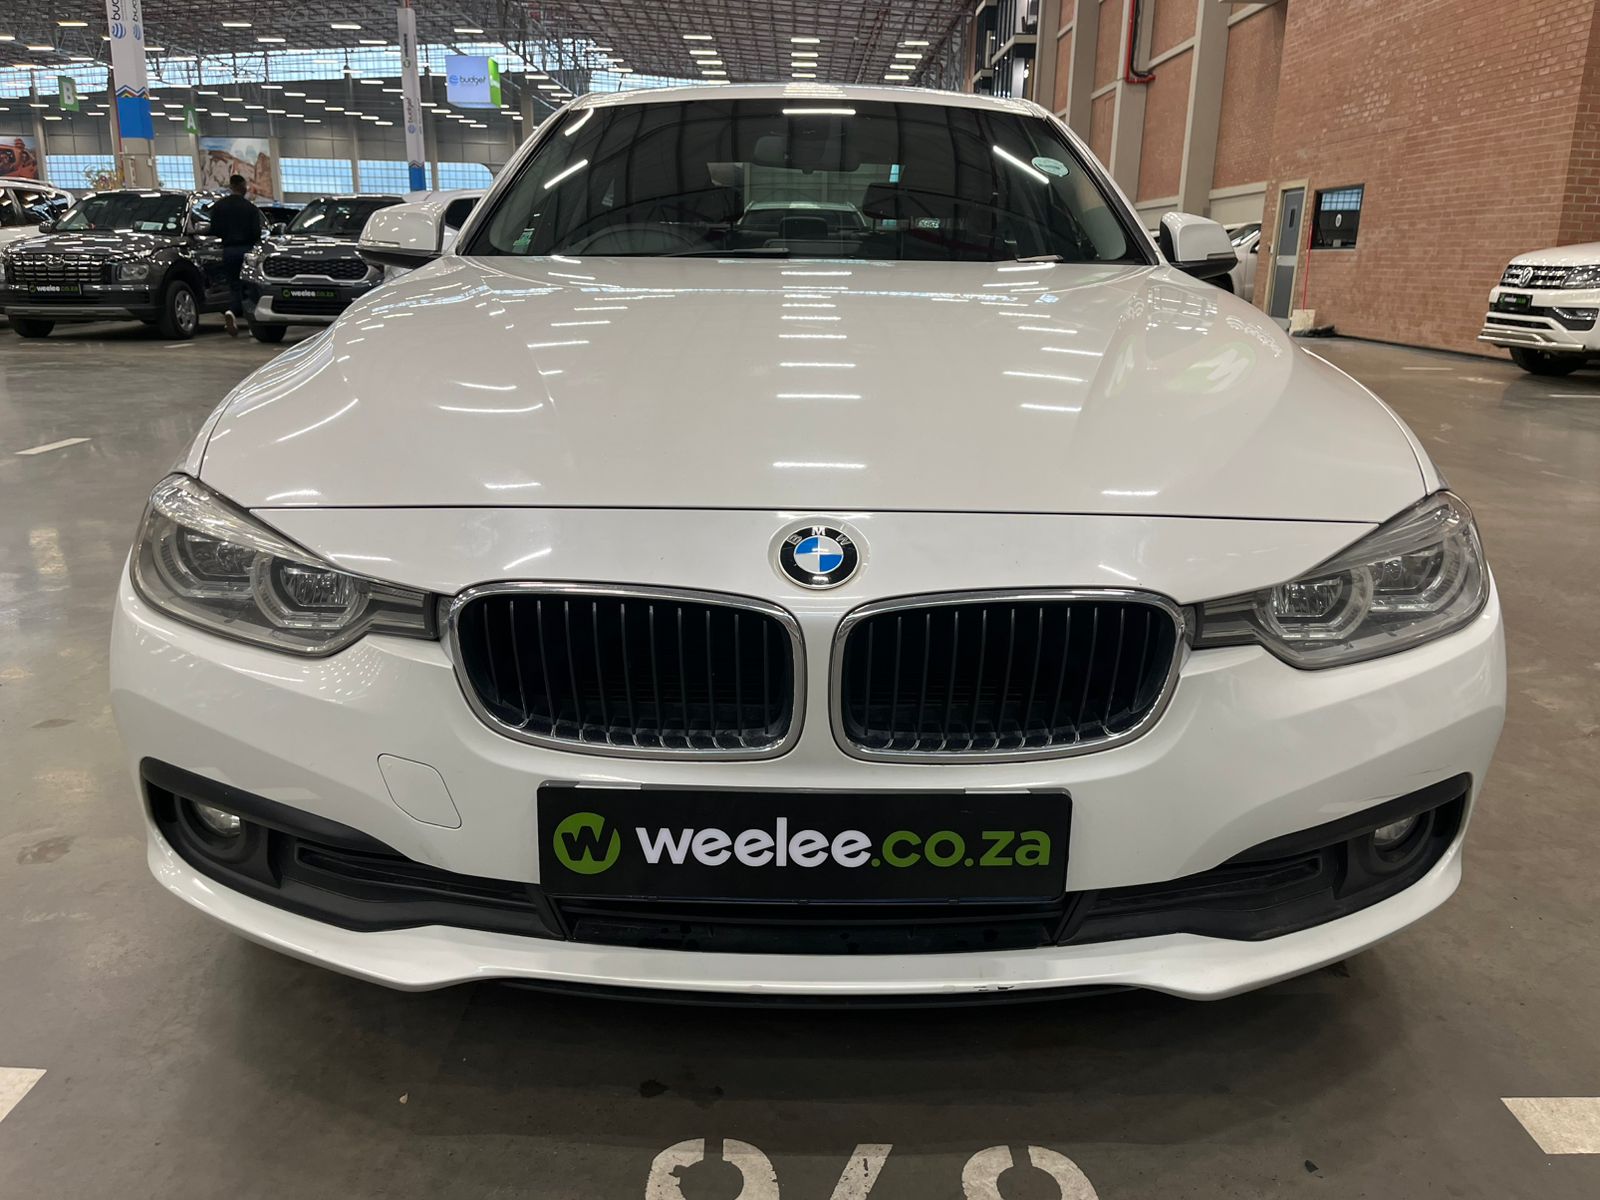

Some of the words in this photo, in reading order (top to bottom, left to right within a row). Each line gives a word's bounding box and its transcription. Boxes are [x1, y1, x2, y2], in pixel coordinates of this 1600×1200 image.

[62, 81, 75, 105] B
[187, 110, 197, 130] A
[786, 526, 852, 546] BMW
[634, 816, 1052, 869] weelee.co.za
